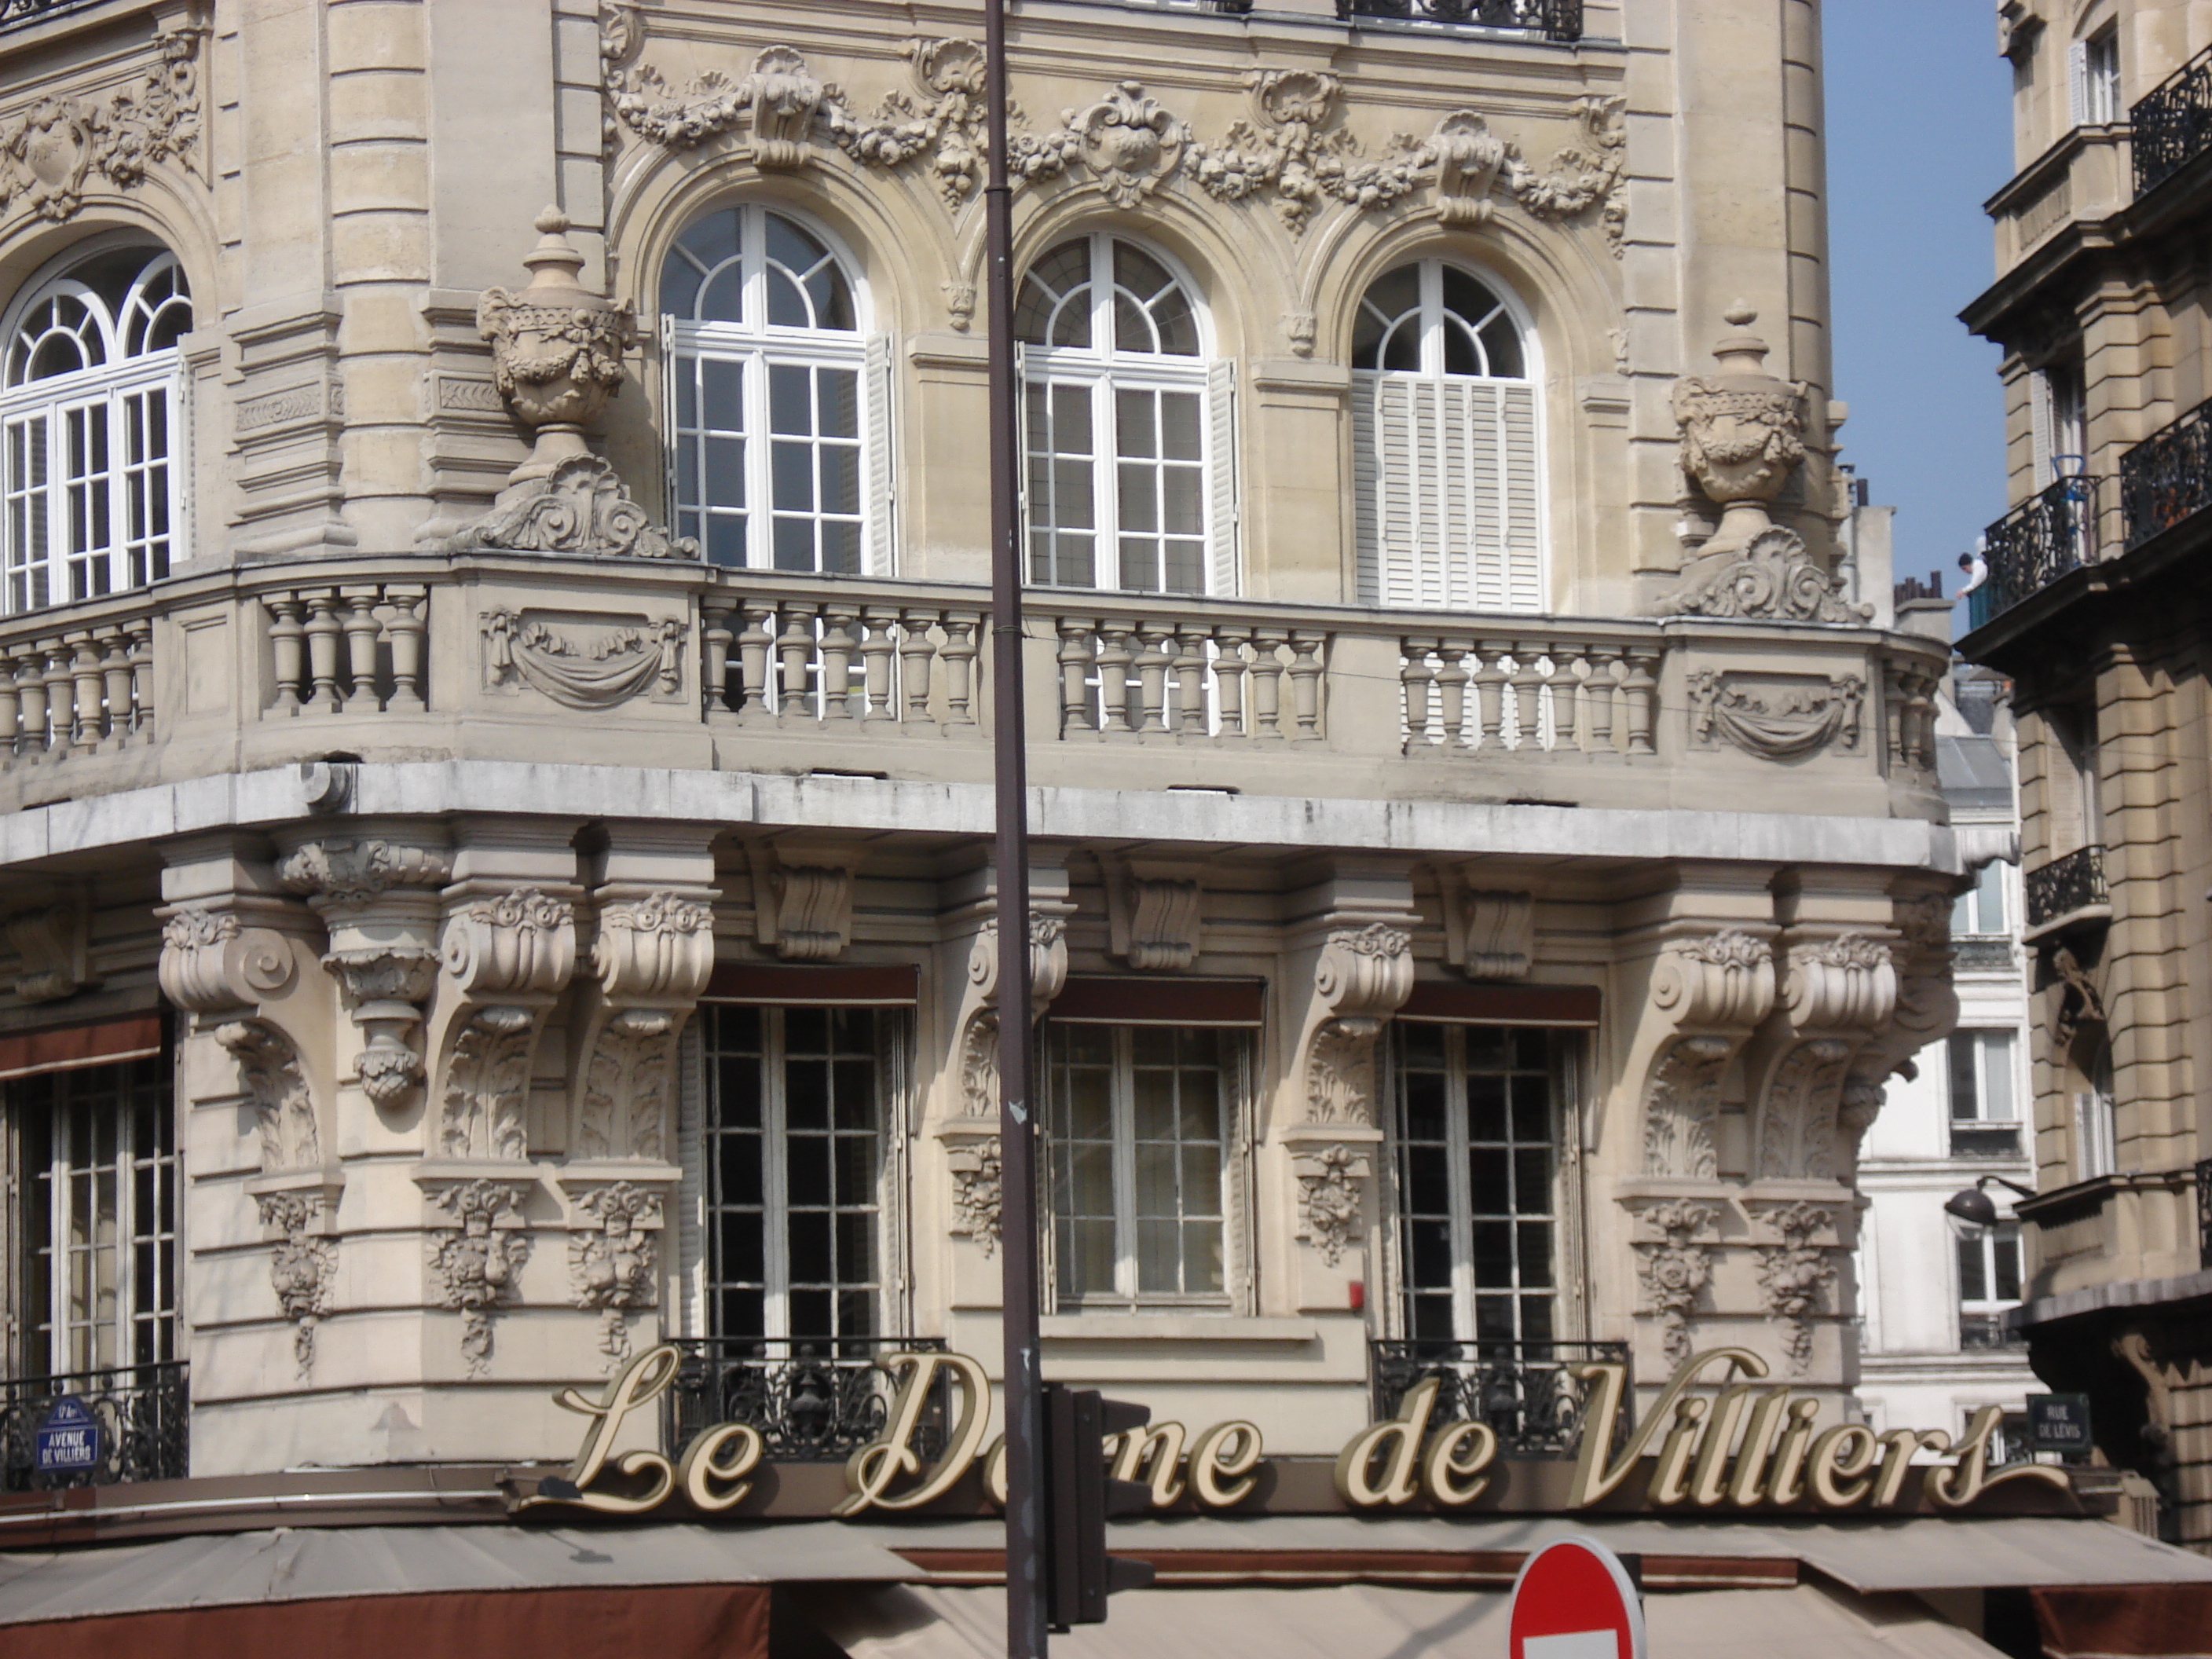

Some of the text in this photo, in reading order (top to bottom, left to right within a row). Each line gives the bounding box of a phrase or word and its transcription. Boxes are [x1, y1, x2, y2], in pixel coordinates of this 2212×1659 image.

[2047, 1404, 2069, 1420] RUE
[49, 1430, 85, 1447] AVENUE
[507, 1343, 2069, 1517] Le Dme de Villiers
[2038, 1423, 2052, 1437] DE
[42, 1445, 91, 1464] DE VILLIERS
